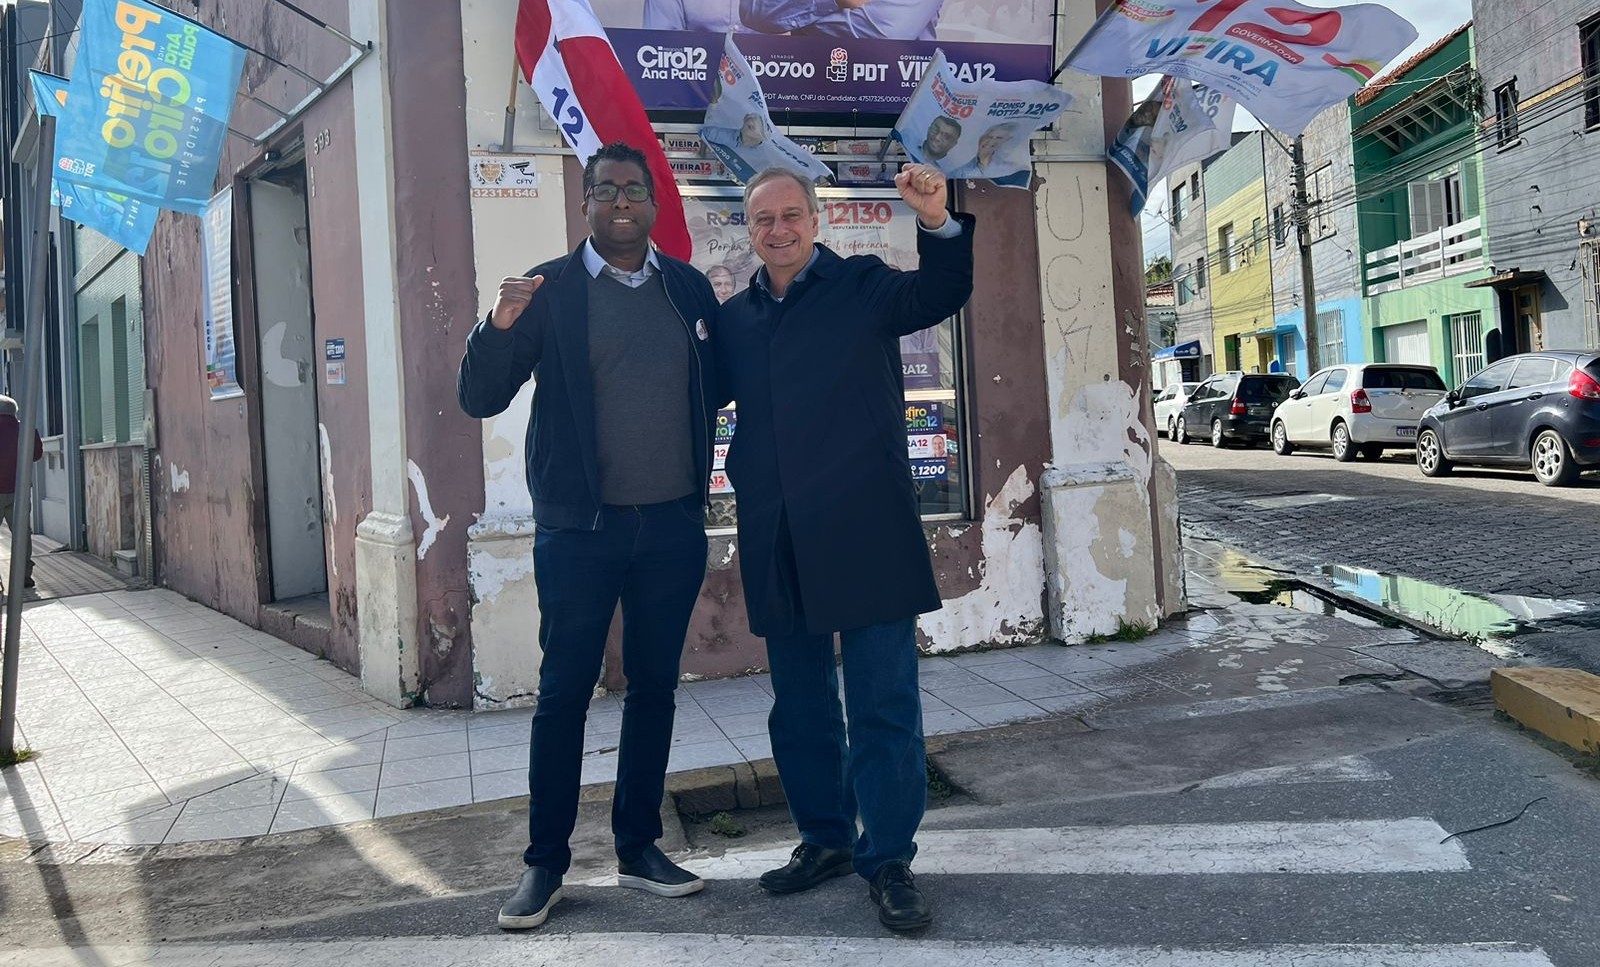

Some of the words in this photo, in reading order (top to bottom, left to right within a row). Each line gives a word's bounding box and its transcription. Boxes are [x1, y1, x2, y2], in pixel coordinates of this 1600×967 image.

[1119, 7, 1147, 21] PODE
[1231, 25, 1299, 63] GOVERNADOR
[637, 45, 708, 70] Ciro12
[1145, 35, 1280, 87] VIEIRA
[641, 67, 668, 79] Ana
[671, 68, 707, 81] Paula
[751, 61, 816, 78] DO700
[853, 63, 889, 82] PDT
[897, 61, 996, 83] VIRA12
[800, 93, 816, 101] CNPJ
[826, 94, 857, 102] Candidato:
[987, 109, 1018, 117] MOTTA
[989, 102, 1025, 110] AFONSO
[552, 87, 584, 147] 12
[670, 162, 712, 171] VIEIRA12
[474, 189, 536, 198] 3231.1546
[706, 210, 748, 226] ROS
[827, 202, 892, 224] 12130
[902, 364, 928, 375] RA12
[905, 406, 927, 419] firo
[907, 439, 928, 447] A12
[918, 465, 945, 476] 1200
[710, 476, 725, 485] A12
